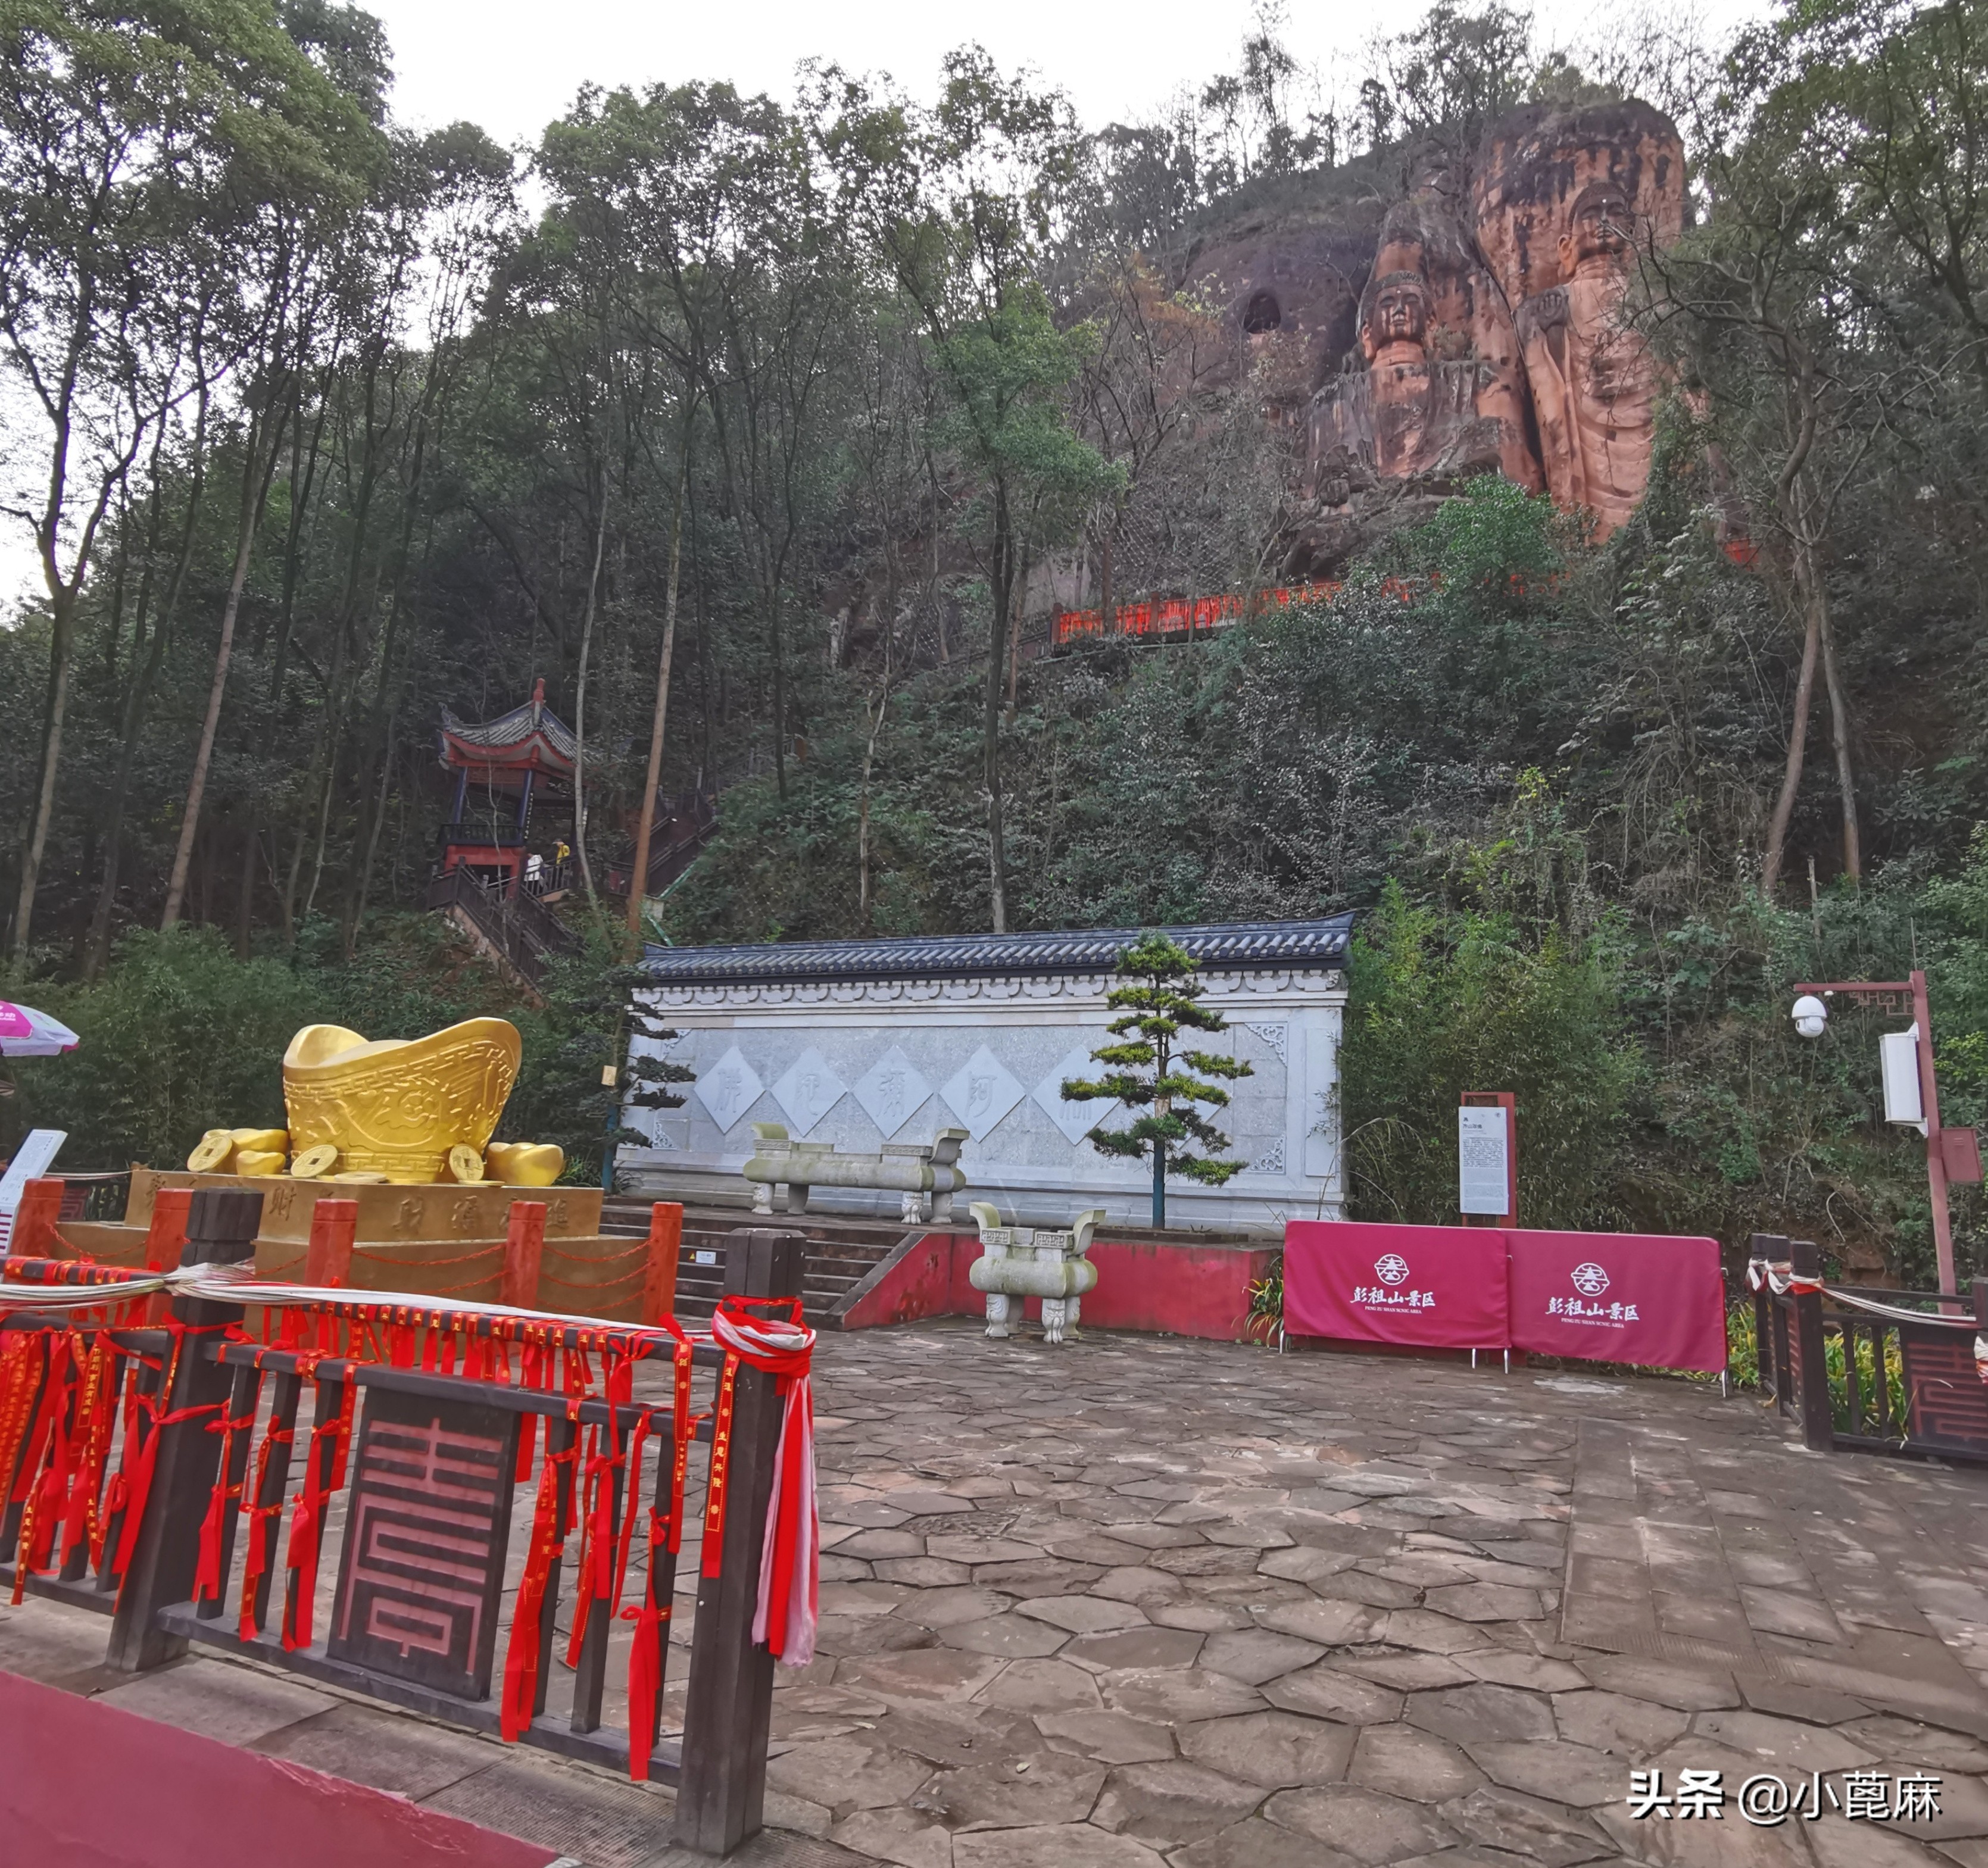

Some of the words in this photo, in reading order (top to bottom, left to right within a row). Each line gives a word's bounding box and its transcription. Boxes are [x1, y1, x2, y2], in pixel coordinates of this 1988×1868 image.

[1350, 1286, 1435, 1307] 彭祖山景区
[1545, 1297, 1639, 1321] 彭祖山景区
